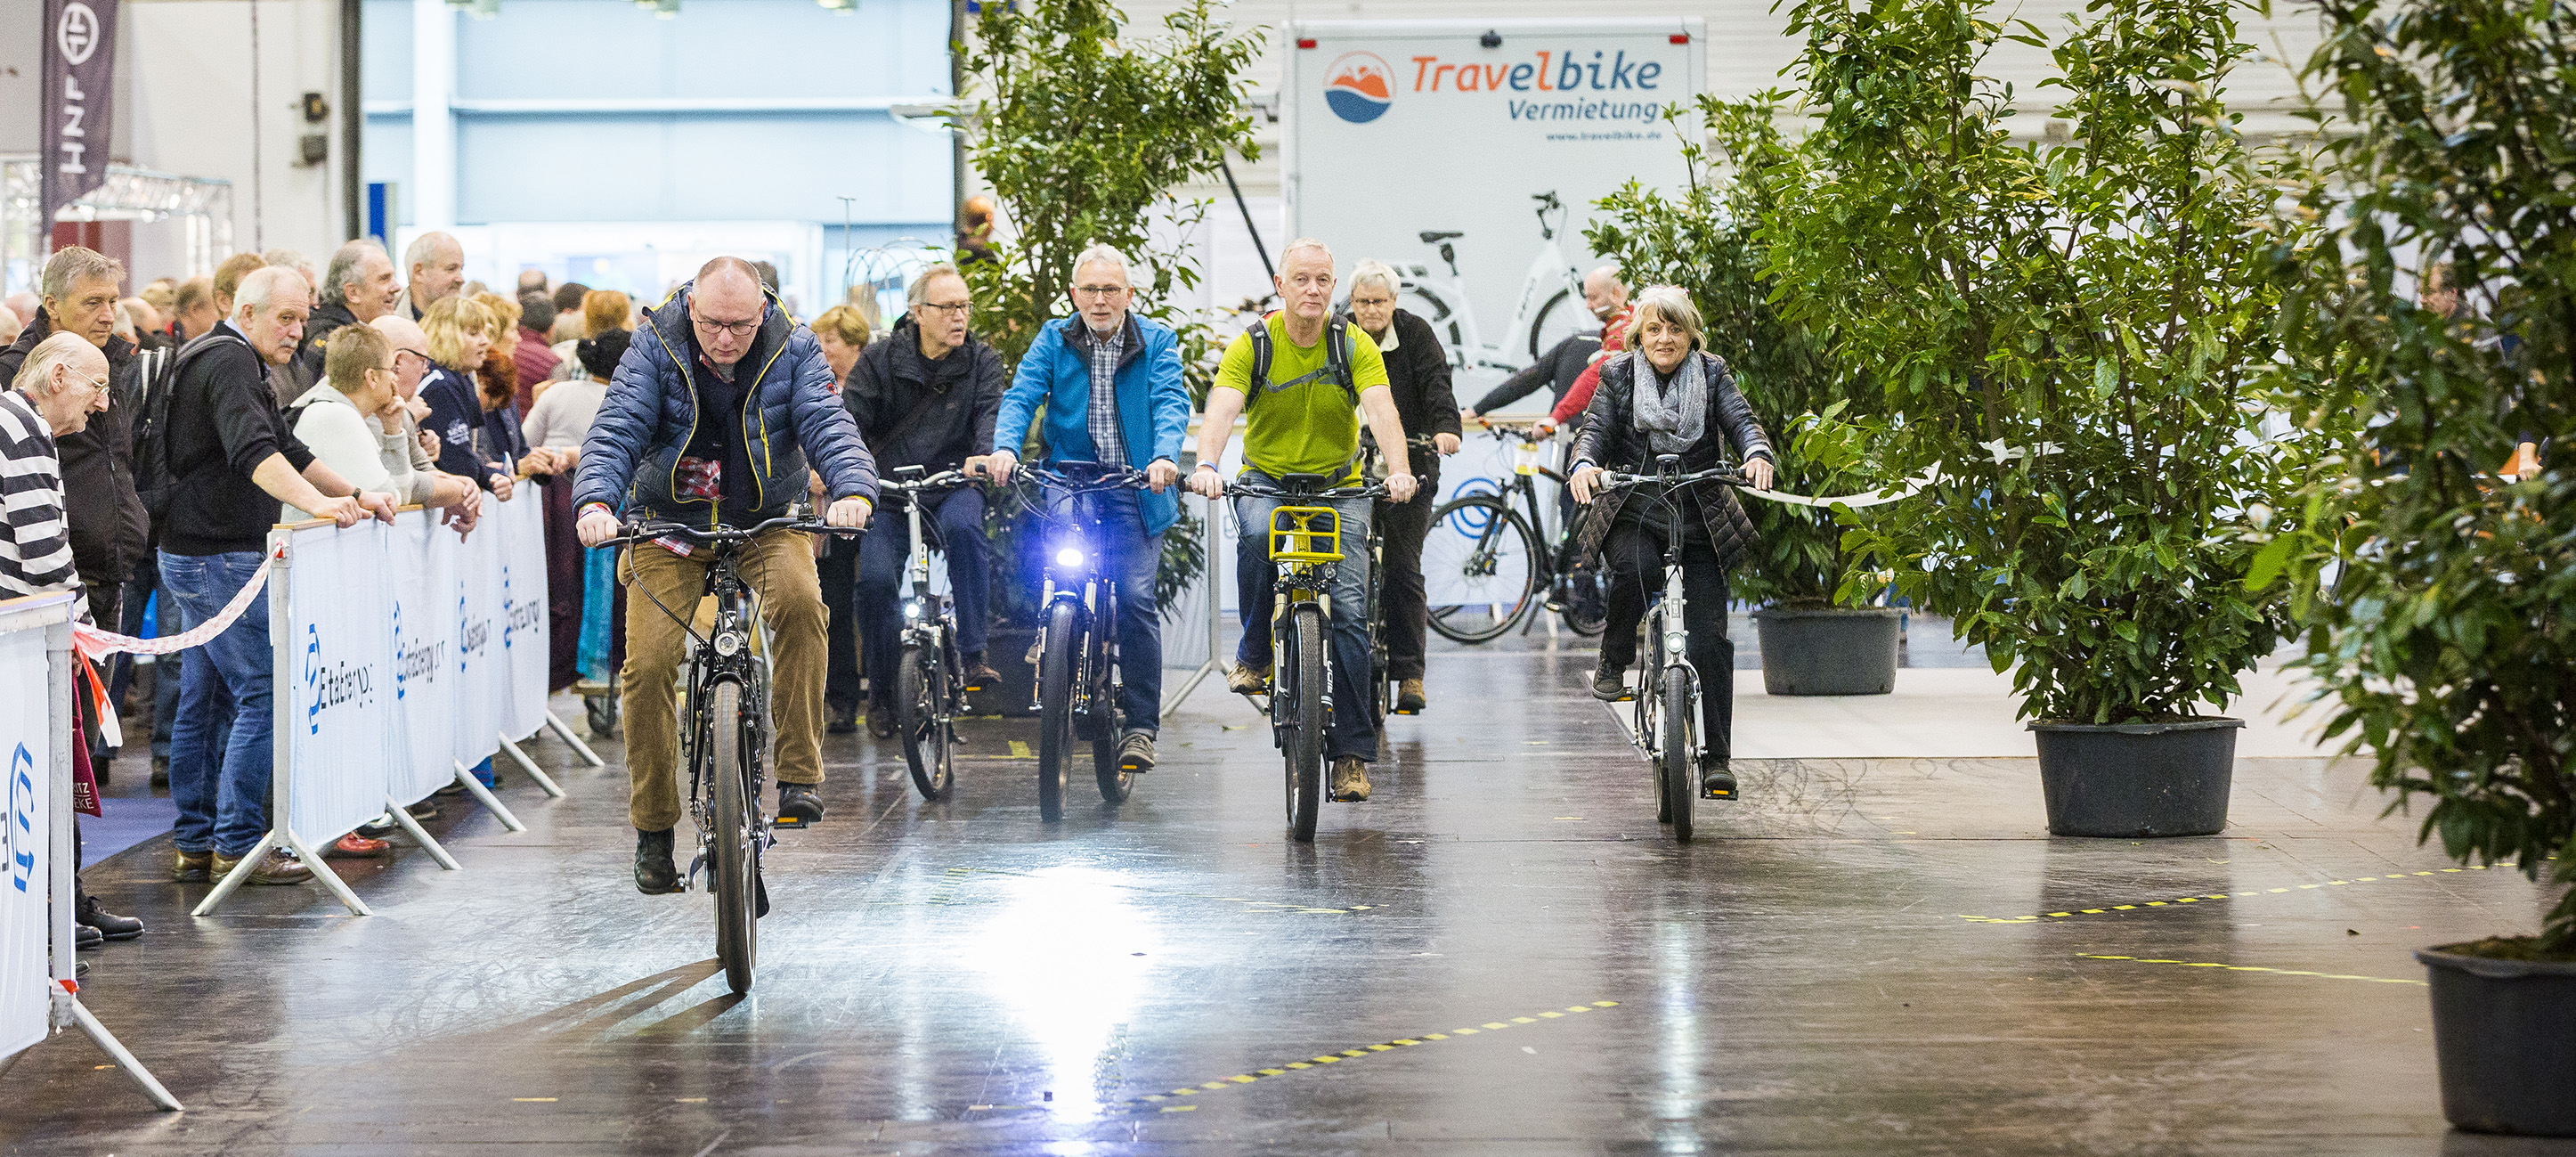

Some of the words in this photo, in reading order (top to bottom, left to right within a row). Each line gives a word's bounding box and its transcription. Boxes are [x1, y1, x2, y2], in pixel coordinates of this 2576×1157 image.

[1410, 50, 1662, 93] Travelbike
[59, 75, 87, 175] HNF
[1508, 97, 1659, 124] Vermietung
